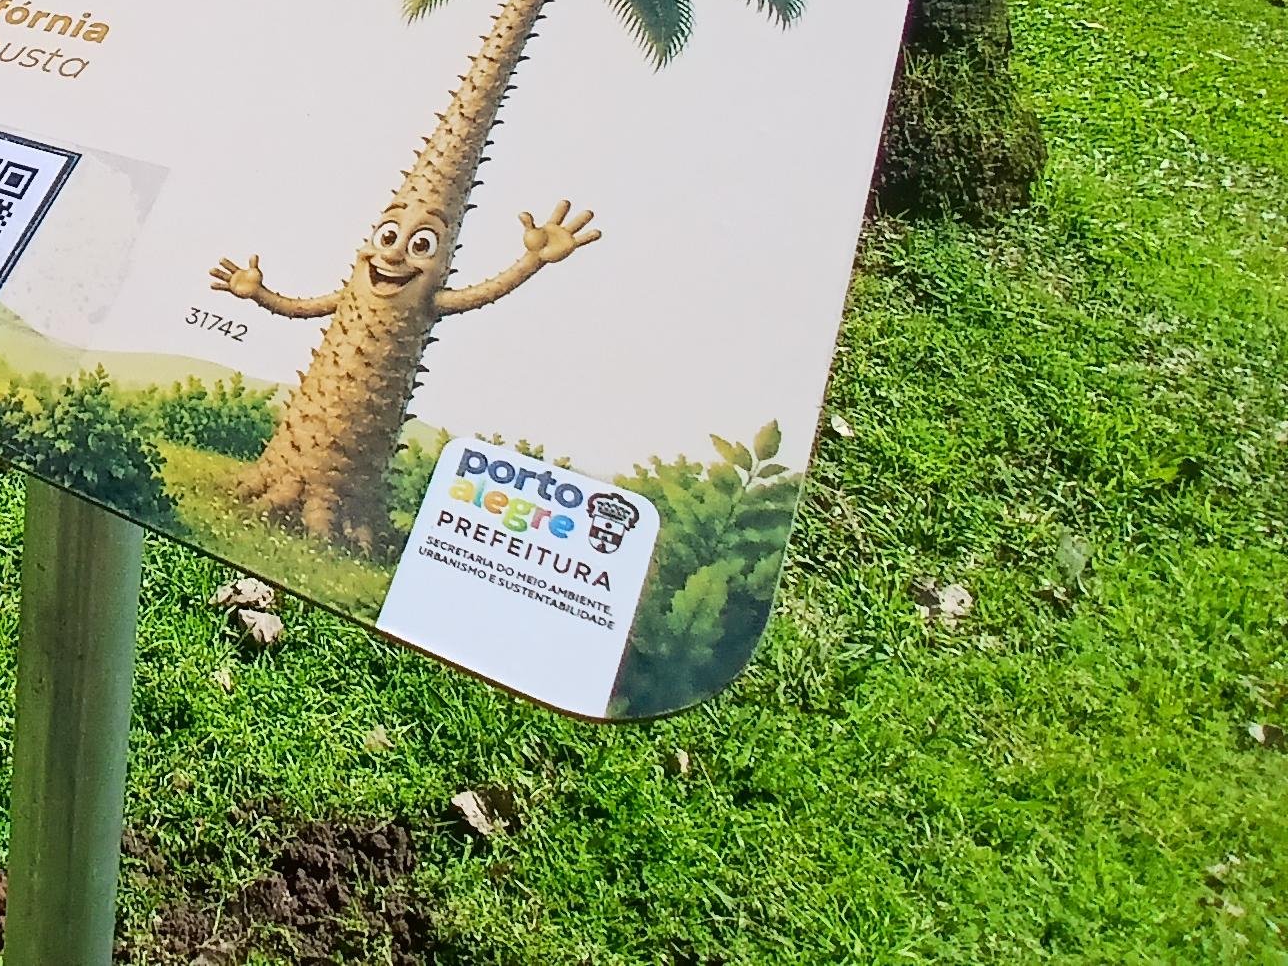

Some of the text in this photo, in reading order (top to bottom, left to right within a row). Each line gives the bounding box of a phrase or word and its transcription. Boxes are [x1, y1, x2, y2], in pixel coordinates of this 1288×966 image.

[185, 307, 248, 342] 31742
[448, 478, 575, 539] alegre
[455, 448, 584, 509] porto
[425, 535, 494, 570] SECRETARIA
[496, 563, 514, 577] DO
[516, 571, 547, 589] MEIO
[436, 510, 611, 592] PREFEITURA
[418, 545, 616, 630] URBANISMO E SUSTENTABILIDADE
